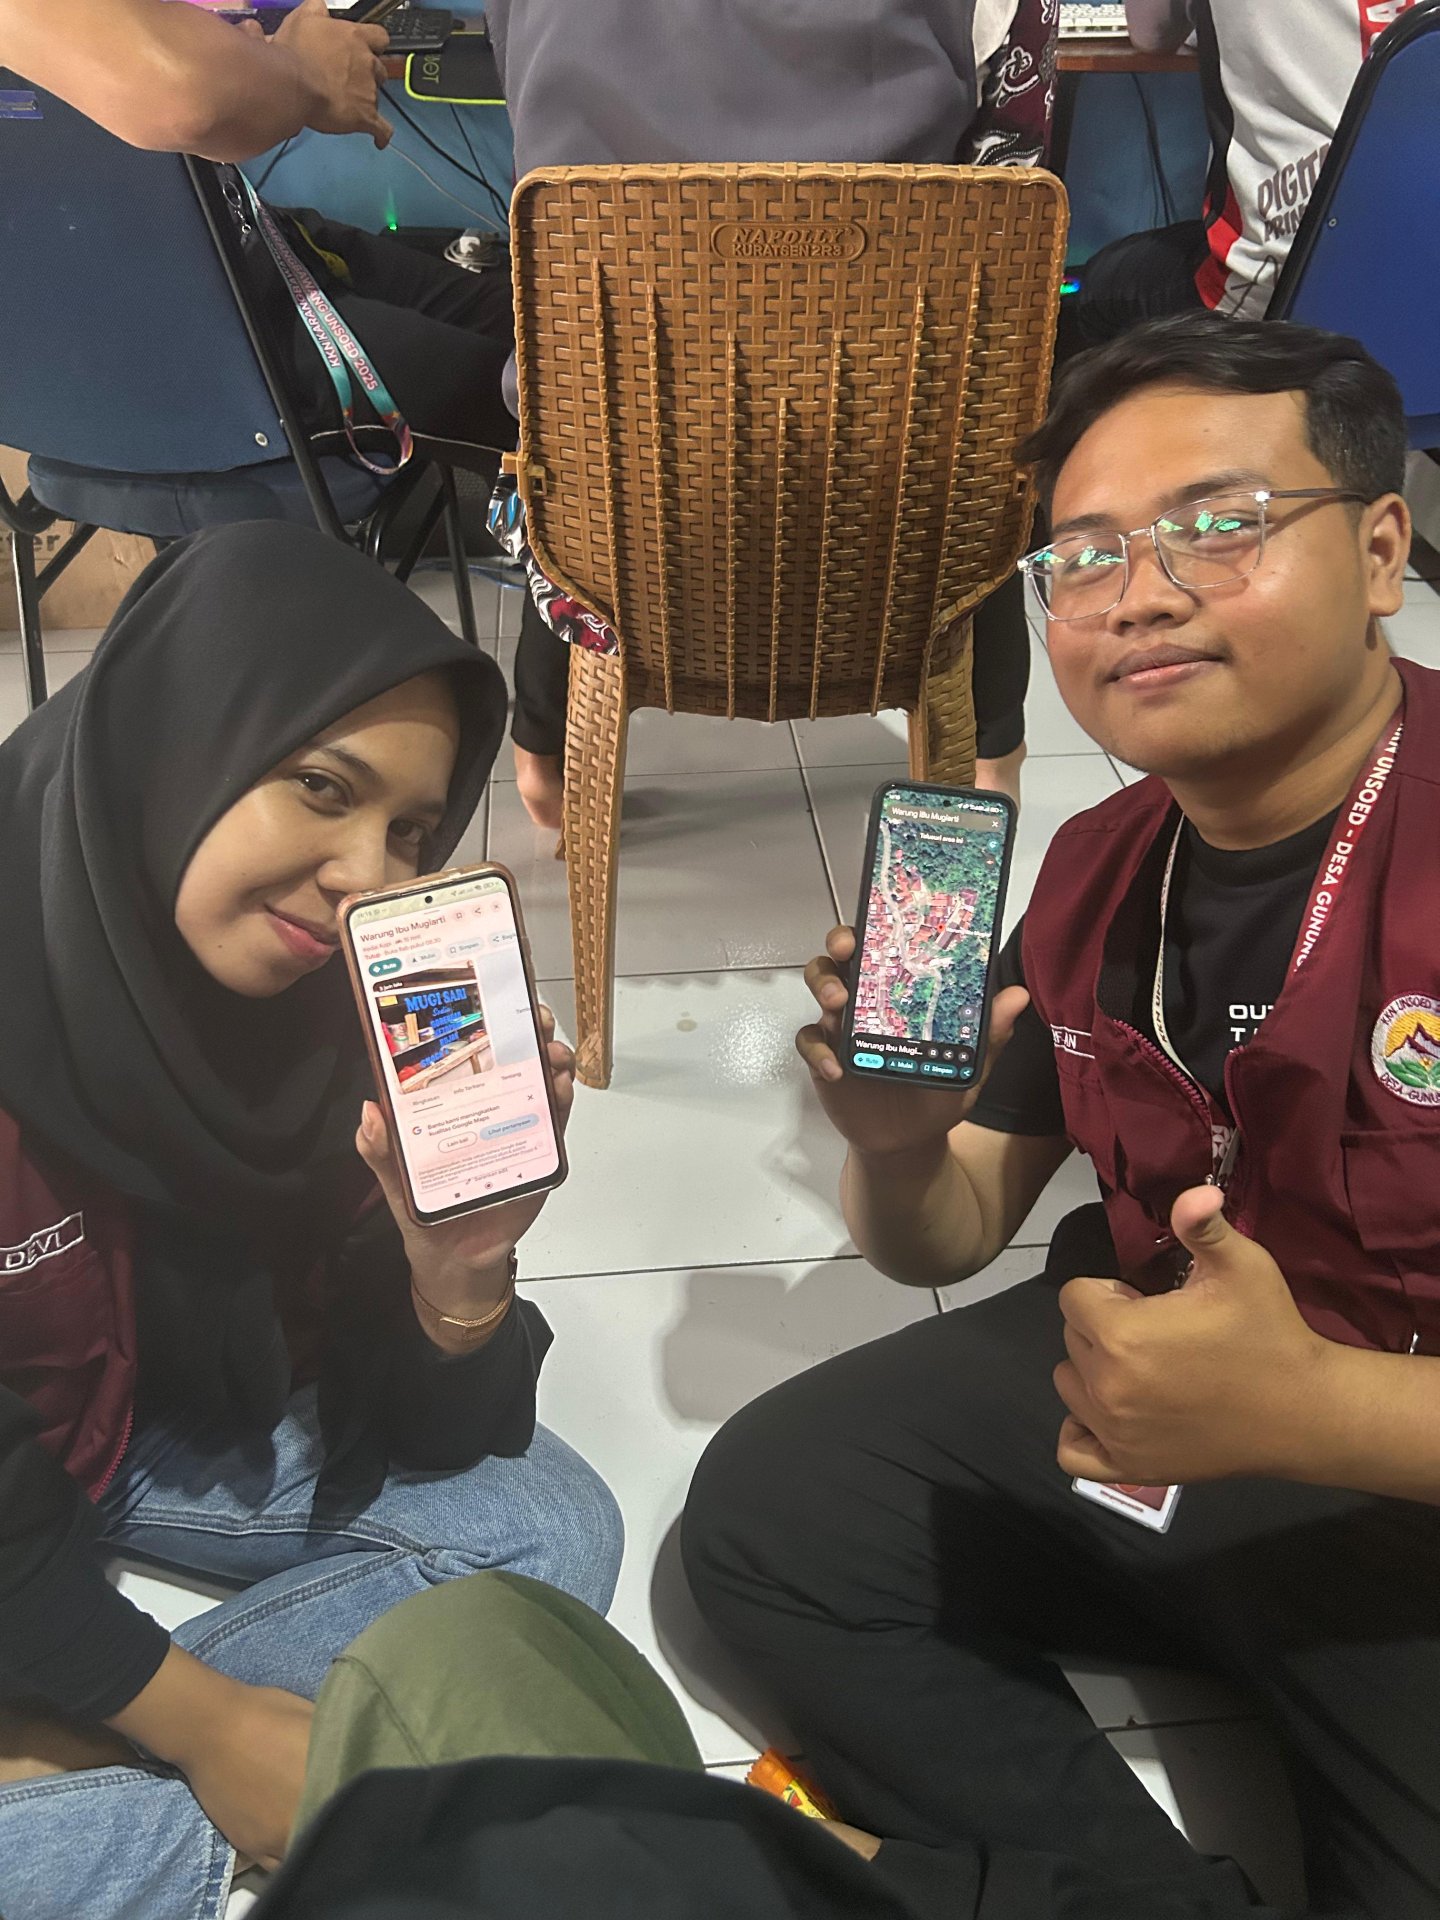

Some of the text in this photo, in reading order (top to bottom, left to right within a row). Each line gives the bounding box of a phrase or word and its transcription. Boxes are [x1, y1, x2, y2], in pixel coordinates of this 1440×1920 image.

[732, 228, 844, 244] NAPOLLY
[321, 341, 341, 368] KKN
[324, 309, 360, 358] UNSOED
[354, 357, 379, 391] 2025
[1348, 756, 1395, 826] UNSOED
[892, 807, 918, 819] Warung
[1322, 841, 1354, 887] DESA
[360, 916, 446, 942] Warung Ibu Mugiarti
[404, 988, 468, 1013] MUGI SARI
[1229, 1004, 1274, 1020] OU
[1380, 1005, 1397, 1026] KKN
[1396, 997, 1431, 1010] UNSOED
[856, 1039, 885, 1052] Warung
[885, 1044, 898, 1053] Ibu
[1380, 1072, 1403, 1094] DESA
[452, 1120, 473, 1132] Google
[474, 1115, 490, 1125] Maps
[5, 1231, 63, 1270] DEVI
